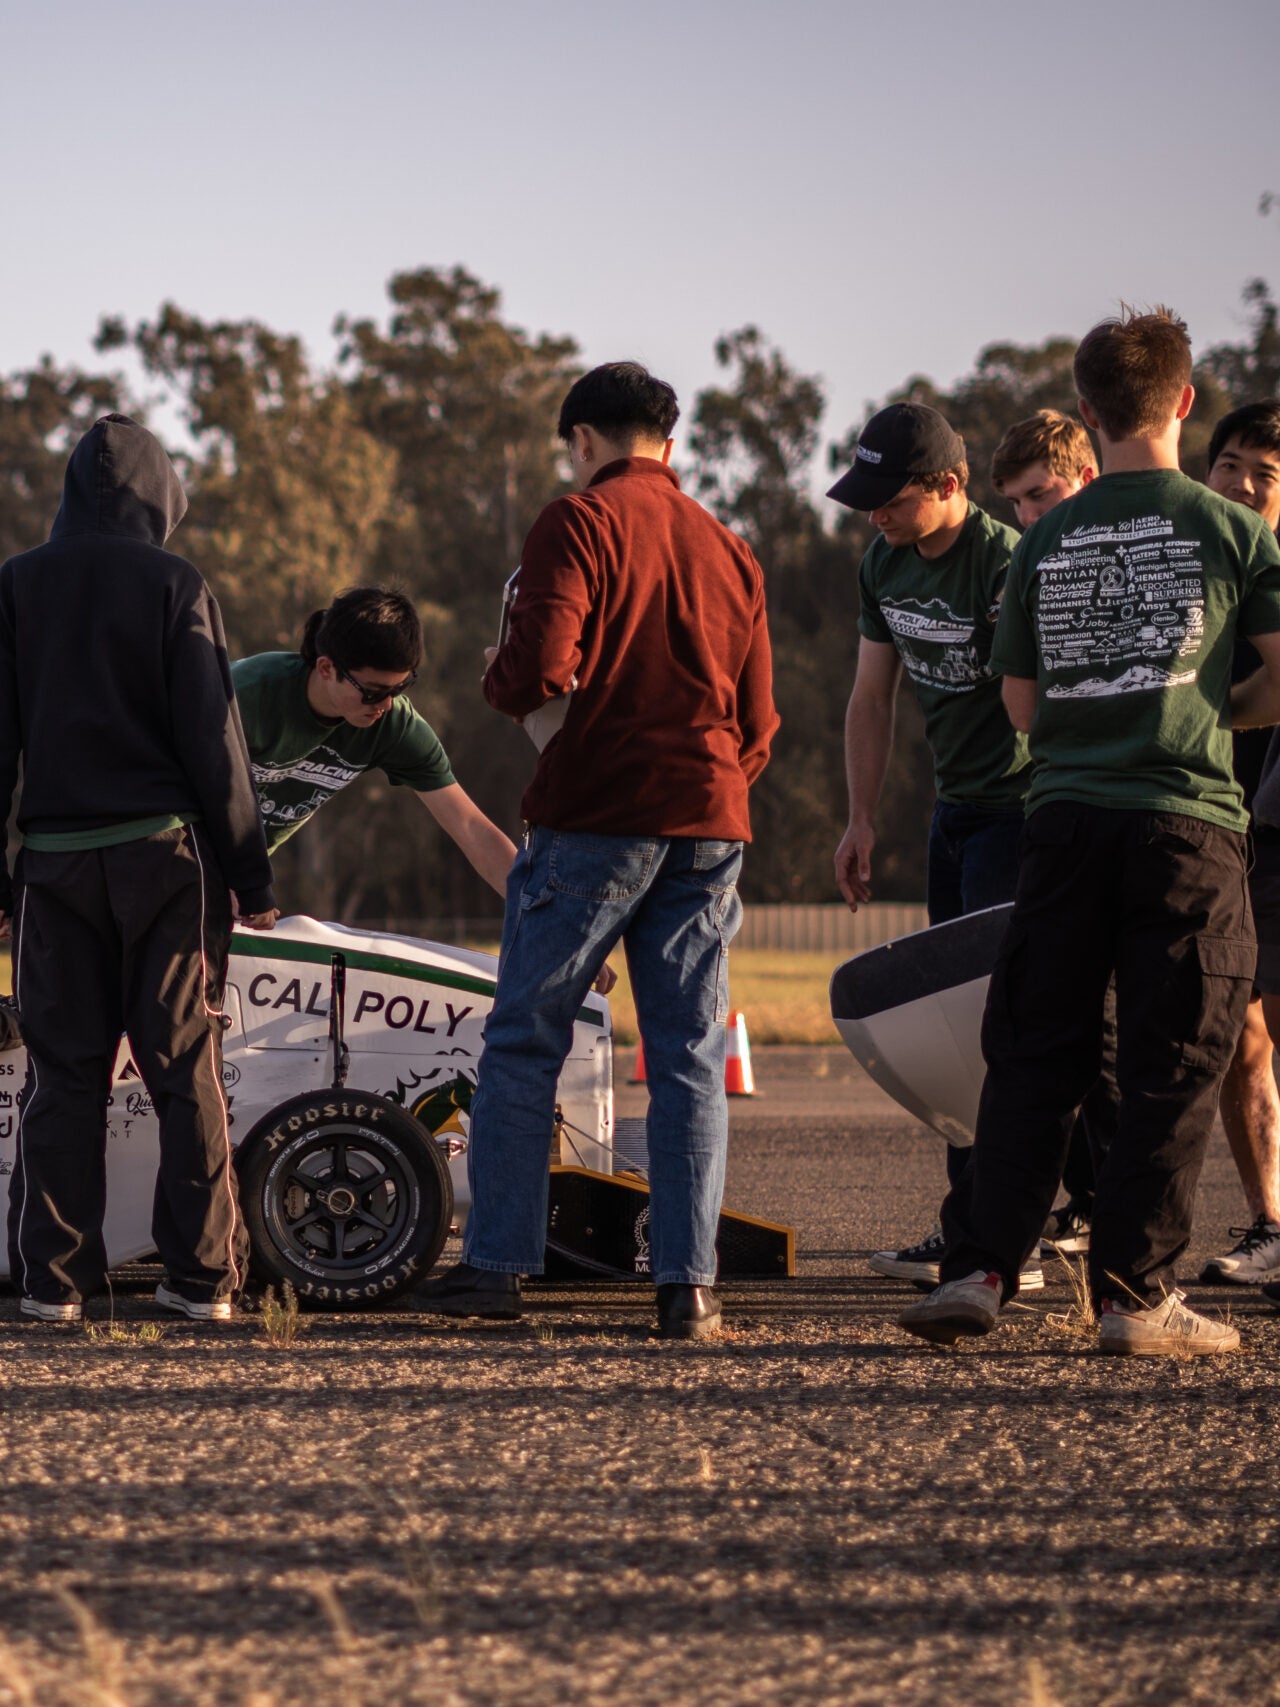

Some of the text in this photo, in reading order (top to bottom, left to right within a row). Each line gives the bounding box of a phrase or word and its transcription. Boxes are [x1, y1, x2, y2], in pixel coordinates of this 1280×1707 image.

[1135, 520, 1173, 530] HANGAR
[1136, 515, 1160, 524] AERO
[1062, 524, 1114, 539] Mustang
[1068, 535, 1098, 545] STUDENT
[1143, 528, 1165, 536] SHOPS
[1057, 546, 1100, 560] Mechanical
[1128, 542, 1163, 553] GENERAL
[1071, 554, 1116, 566] Engineering
[1131, 550, 1160, 560] BATEMO
[1136, 563, 1168, 572] Michigan
[1169, 560, 1202, 568] Scientific
[1050, 569, 1098, 580] RIVIAN
[1134, 571, 1175, 583] SIEMENS
[1046, 581, 1096, 592] ADVANCE
[1137, 578, 1201, 592] AEROCRAFTED
[1153, 587, 1202, 598] SUPERIOR
[1138, 602, 1170, 611] Ansys
[1175, 599, 1204, 608] Altium
[898, 613, 921, 625] POLY
[1037, 611, 1074, 622] Tektronix
[1085, 619, 1109, 628] Joby
[248, 972, 474, 1038] CAL POLY
[263, 1102, 387, 1152] Hoosier
[269, 1148, 291, 1177] RACING
[394, 1227, 415, 1256] RACING
[303, 1263, 325, 1277] Student
[635, 1262, 651, 1273] Mu
[300, 1254, 417, 1300] Hoosier
